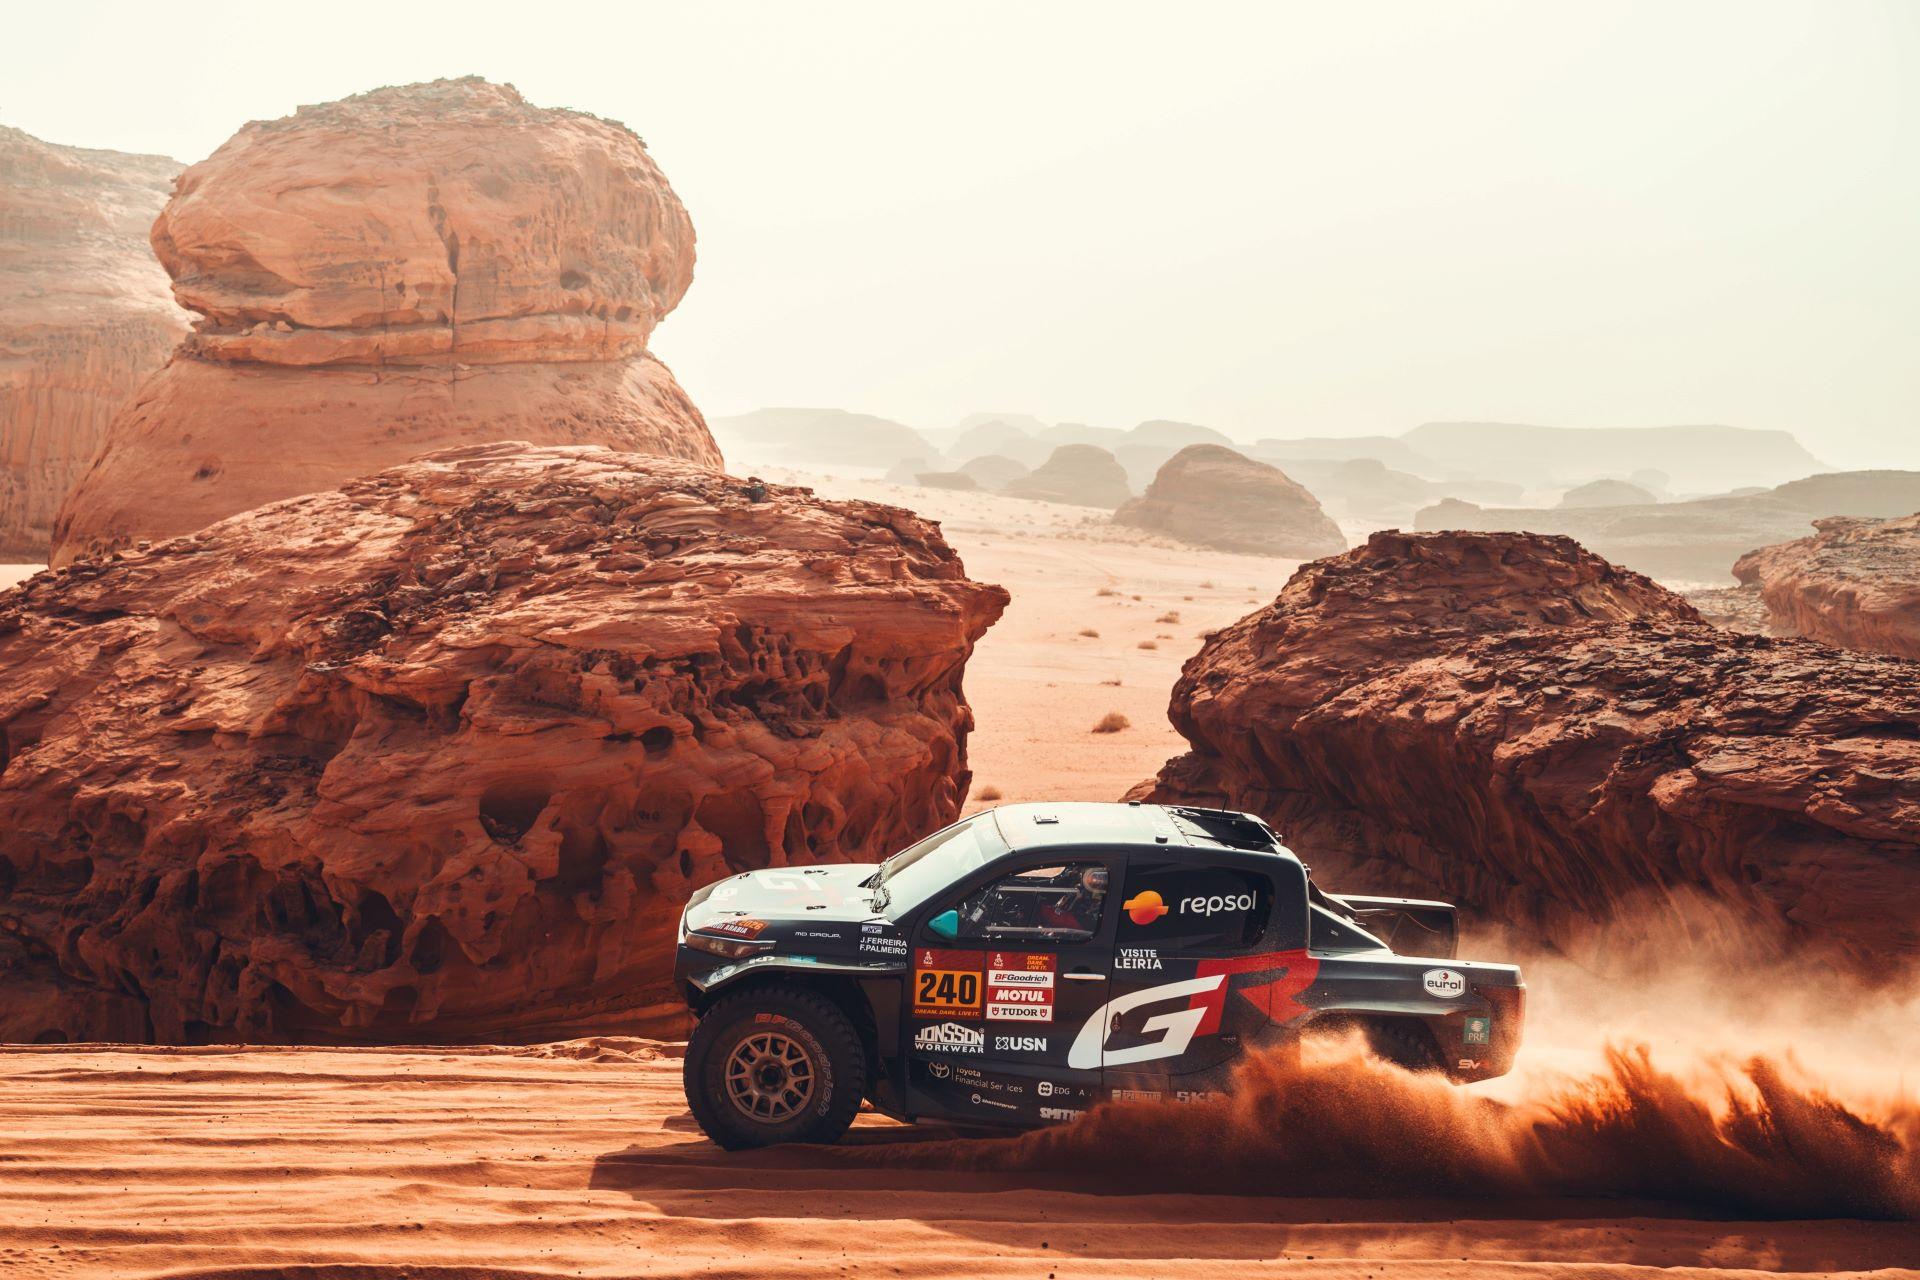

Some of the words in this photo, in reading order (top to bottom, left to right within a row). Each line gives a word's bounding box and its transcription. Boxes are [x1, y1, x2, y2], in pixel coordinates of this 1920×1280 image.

[1180, 890, 1257, 917] repsol
[860, 937, 907, 947] J.FERREIRA
[859, 944, 907, 955] F.PALMEIRO
[1120, 949, 1157, 958] VISITE
[1114, 958, 1162, 970] LEIRIA
[994, 973, 1048, 982] BFGoodrich
[919, 972, 977, 1005] 240
[1427, 980, 1461, 990] eurol
[995, 989, 1045, 1002] MOTUL
[1001, 1008, 1038, 1017] TUDOR
[914, 1022, 985, 1045] JONSSON
[914, 1042, 984, 1054] WORKWEAR
[1009, 1037, 1047, 1051] USN
[955, 1074, 989, 1088] Financial
[990, 1082, 1023, 1093] Serices
